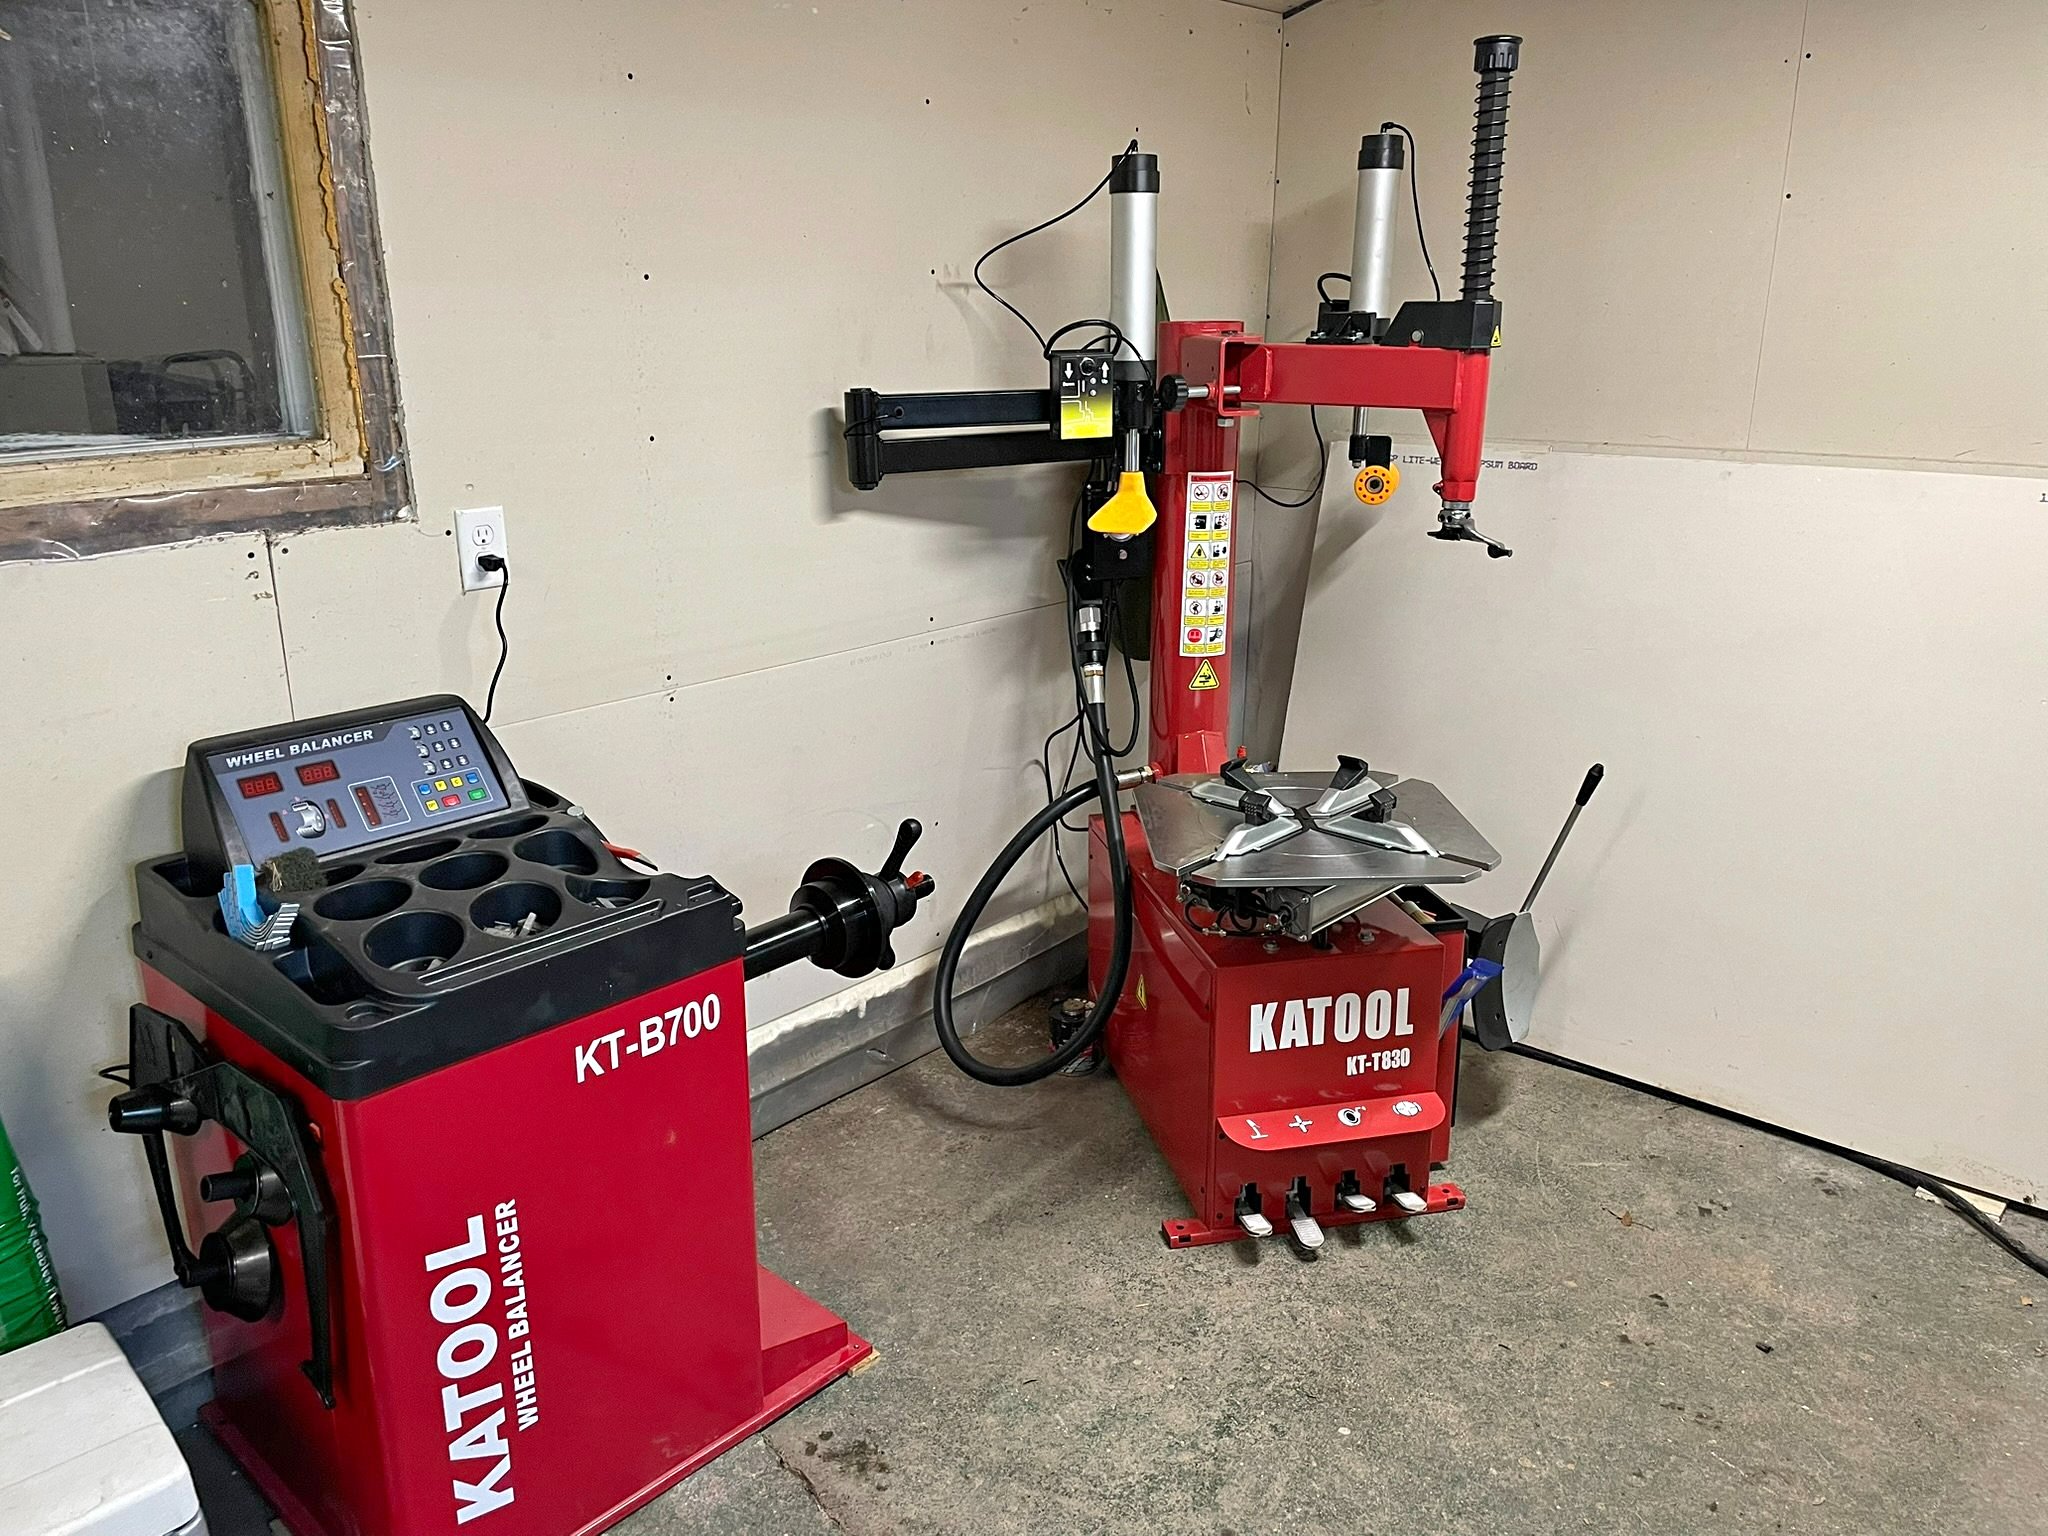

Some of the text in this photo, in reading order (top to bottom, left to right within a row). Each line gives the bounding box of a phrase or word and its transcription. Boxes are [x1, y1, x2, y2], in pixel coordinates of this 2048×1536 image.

[1403, 456, 1440, 465] LITE-WE
[1481, 460, 1503, 469] PSUM
[1508, 461, 1538, 471] BOARD
[226, 729, 374, 768] WHEEL BALANCER
[575, 993, 721, 1084] KT-B700
[1250, 987, 1414, 1053] KATOOL
[1346, 1047, 1411, 1076] KT-T830
[495, 1198, 538, 1432] WHEEL BALANCER
[425, 1214, 515, 1525] KATOOL
